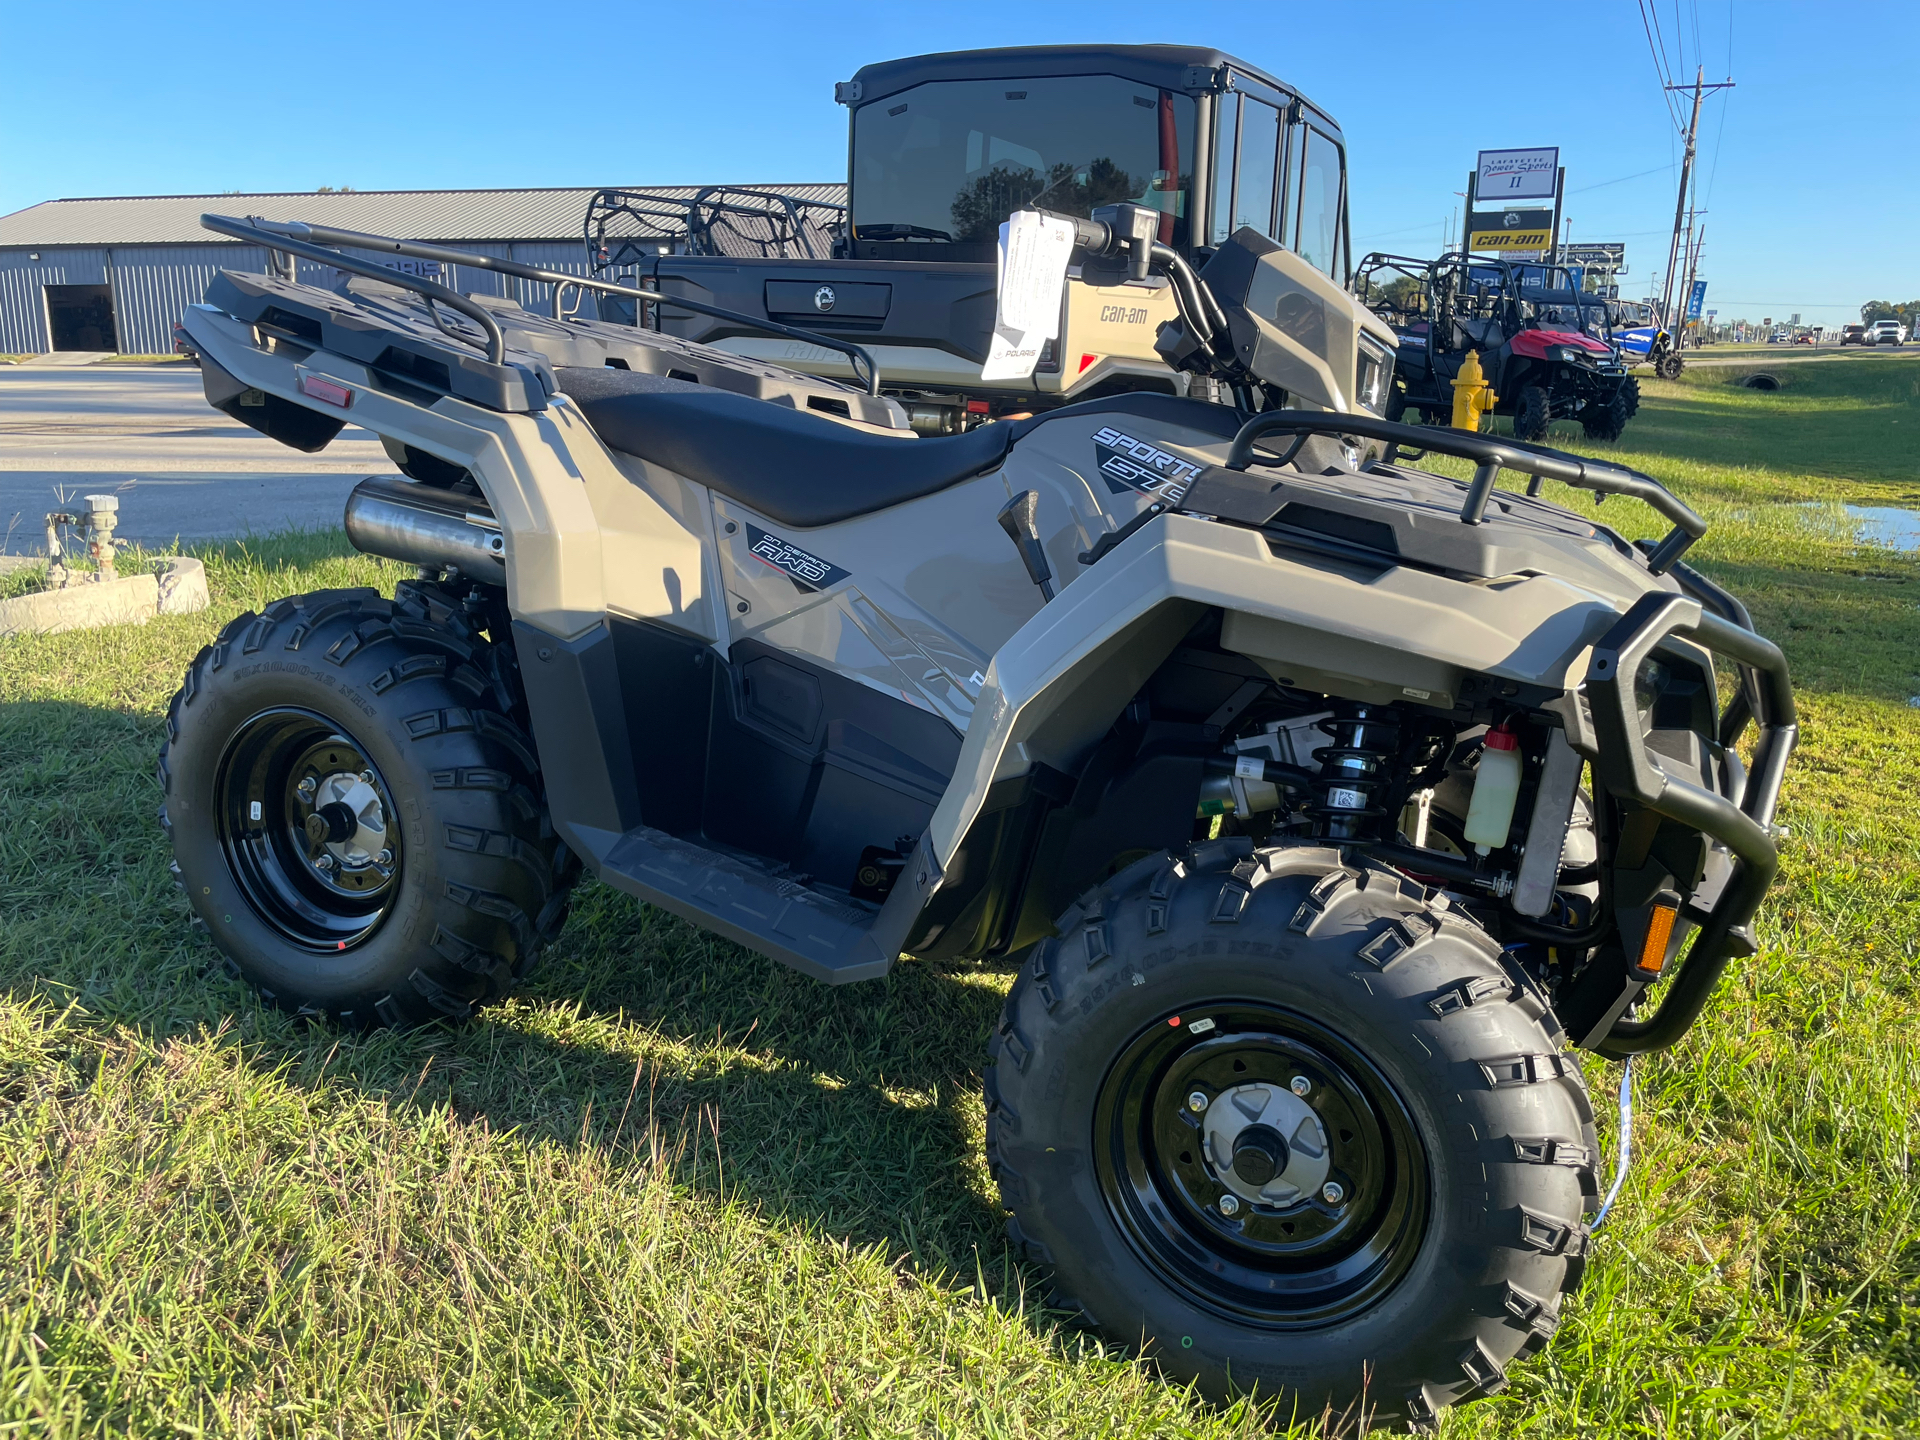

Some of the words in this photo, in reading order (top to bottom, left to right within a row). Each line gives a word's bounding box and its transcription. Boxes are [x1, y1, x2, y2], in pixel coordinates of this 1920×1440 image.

[1482, 164, 1514, 177] Power
[1514, 162, 1553, 174] Sports
[1509, 176, 1522, 188] II
[1476, 234, 1545, 246] can-am
[1100, 305, 1148, 324] can-am
[1005, 350, 1036, 358] POLARIS
[752, 540, 825, 582] AWD
